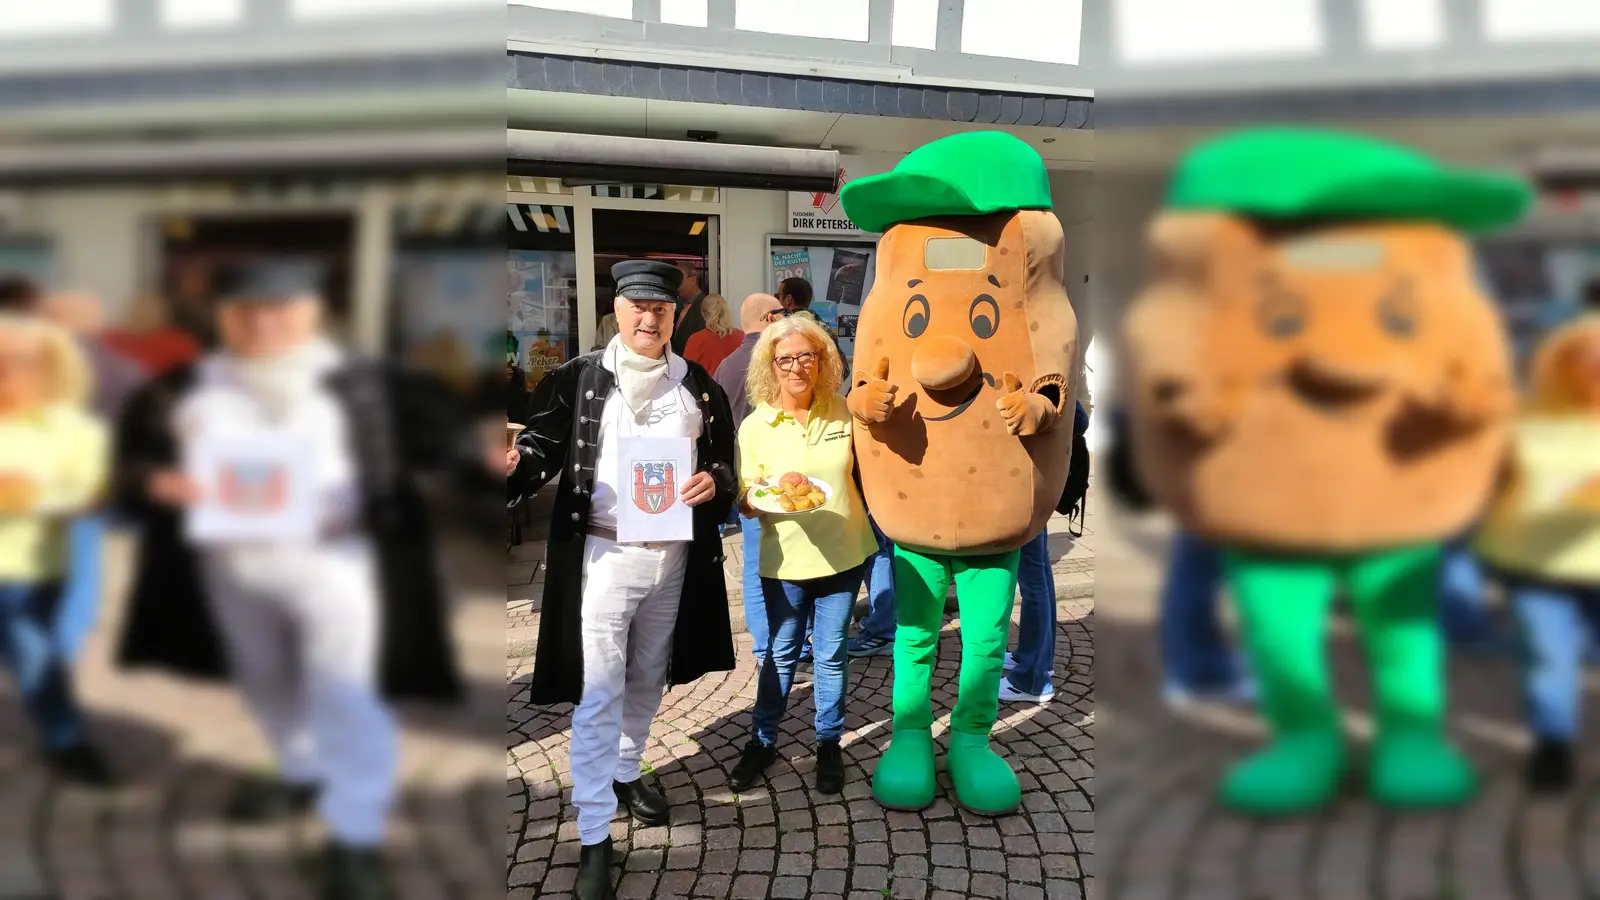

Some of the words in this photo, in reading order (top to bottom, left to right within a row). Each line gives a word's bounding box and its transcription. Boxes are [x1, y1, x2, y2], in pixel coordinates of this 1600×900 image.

[793, 218, 814, 229] DIRK
[816, 219, 859, 230] PETERSEN
[787, 257, 808, 265] KULTUR
[776, 268, 803, 283] 209
